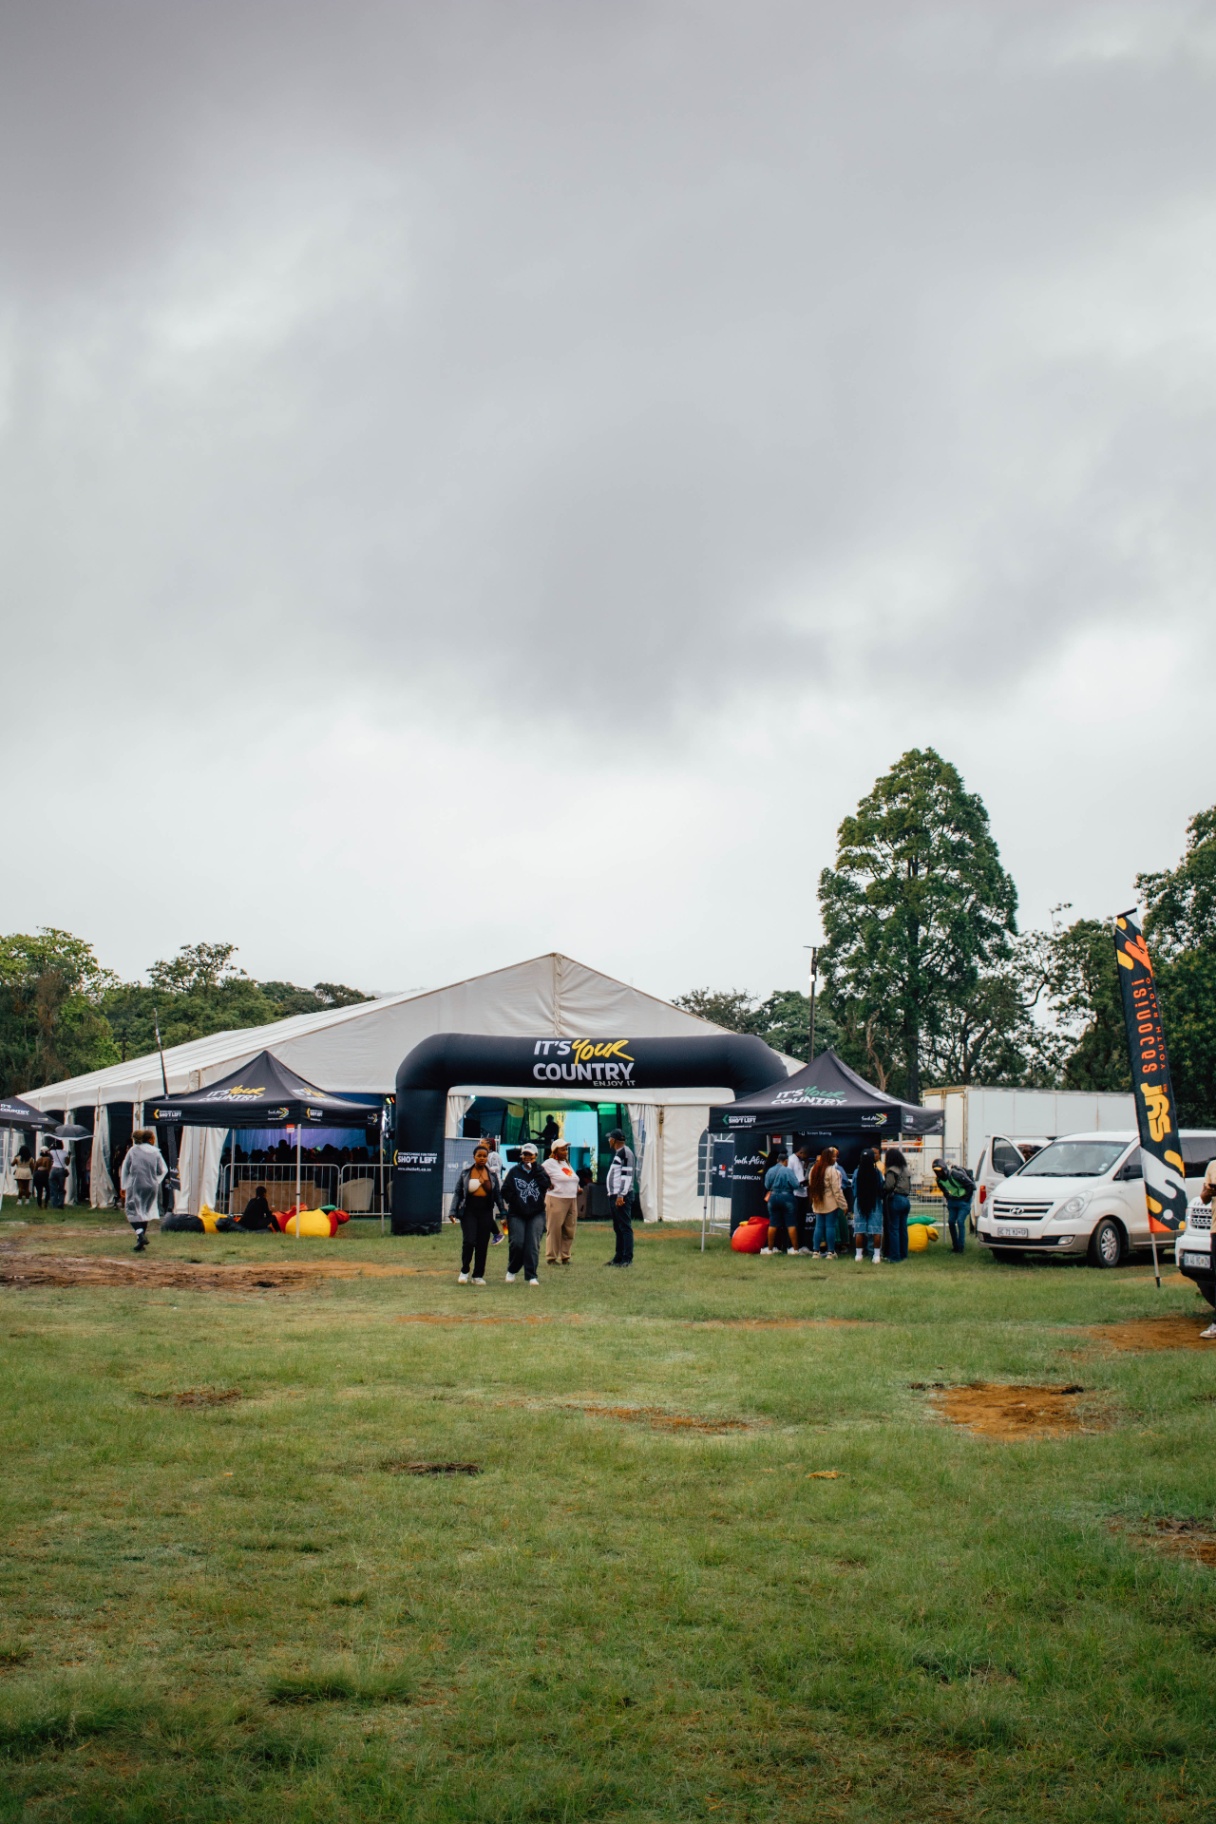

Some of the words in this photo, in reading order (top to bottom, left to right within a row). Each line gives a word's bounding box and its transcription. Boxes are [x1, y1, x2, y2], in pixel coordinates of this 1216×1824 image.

[1145, 976, 1160, 1018] RADIO
[534, 1040, 572, 1056] IT'S
[1155, 1026, 1166, 1070] YOUTH
[533, 1062, 635, 1081] COUNTRY
[775, 1088, 804, 1099] IT'S
[770, 1096, 848, 1106] COUNTRY
[419, 1156, 437, 1164] LEFT
[748, 1155, 766, 1165] Afric
